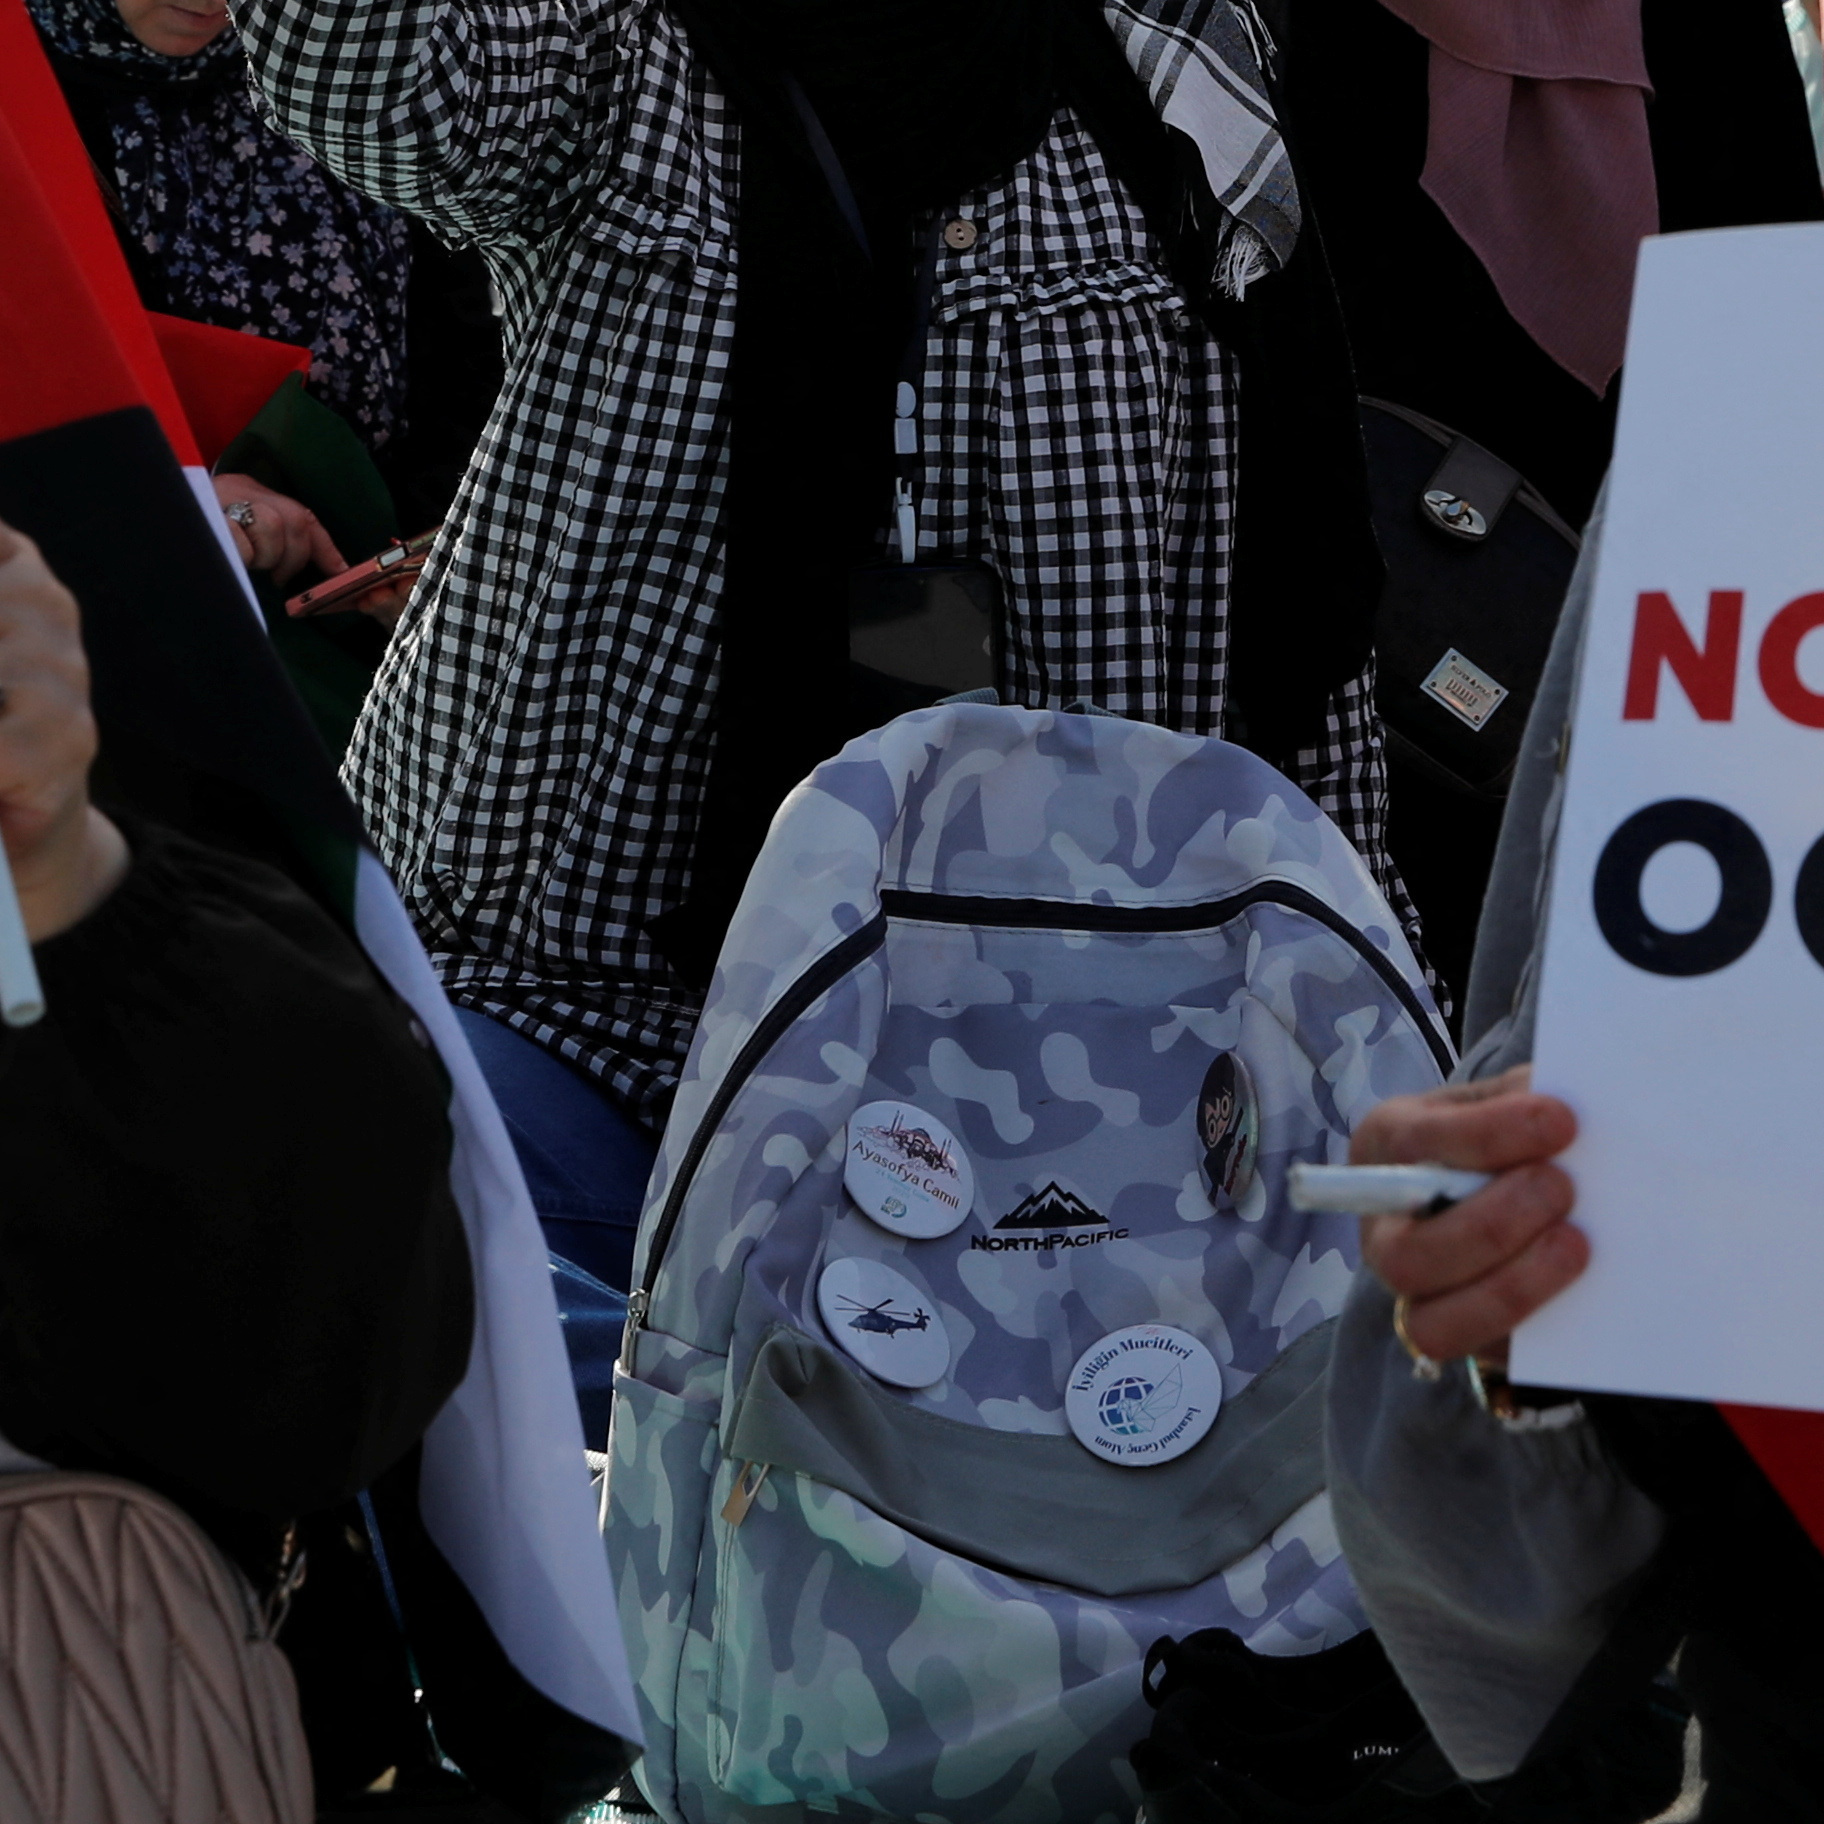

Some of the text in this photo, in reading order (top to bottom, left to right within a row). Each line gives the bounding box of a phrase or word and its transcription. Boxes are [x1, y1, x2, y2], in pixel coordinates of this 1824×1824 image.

[852, 1140, 920, 1186] Ayasofya
[922, 1178, 961, 1210] Camii
[1119, 1336, 1194, 1361] Mucitleri
[1094, 1406, 1202, 1456] İstanbul Genç Atom
